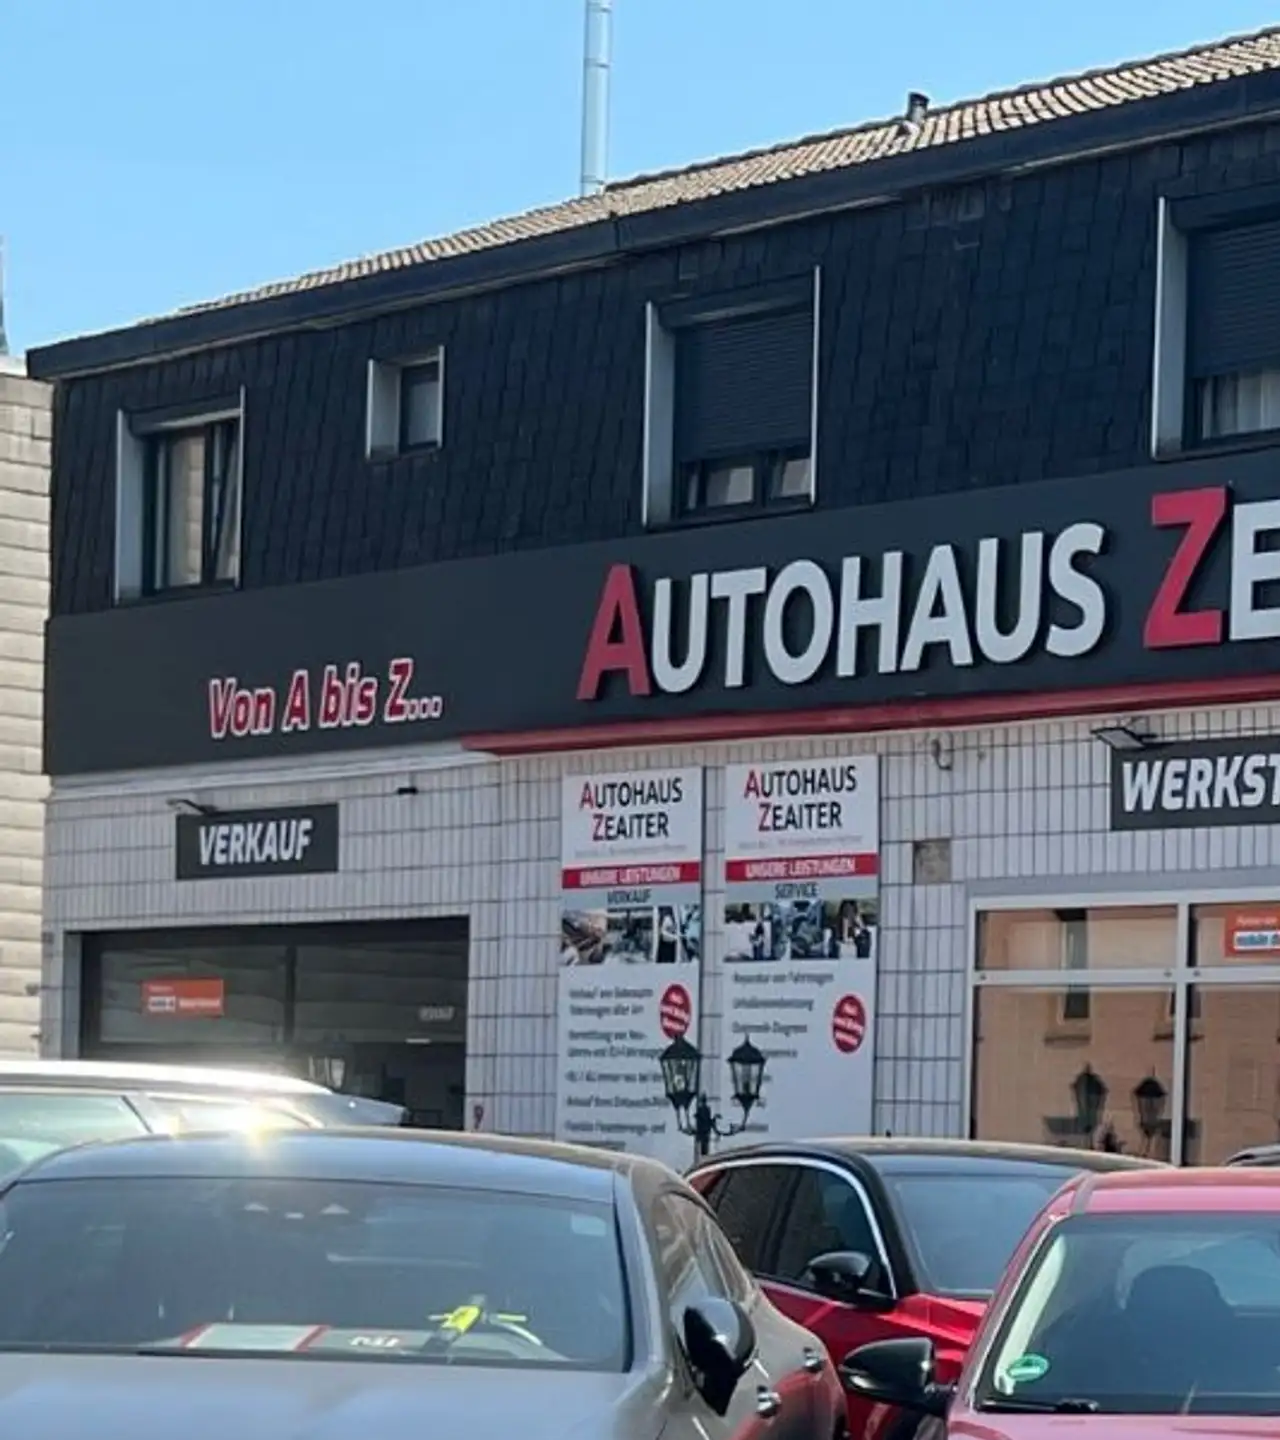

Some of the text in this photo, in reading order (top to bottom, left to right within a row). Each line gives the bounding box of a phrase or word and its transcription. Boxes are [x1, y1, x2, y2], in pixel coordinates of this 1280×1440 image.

[576, 520, 1106, 702] AUTOHAUS
[209, 676, 275, 738] Von
[281, 669, 310, 731] A
[318, 661, 378, 728] bis
[580, 777, 683, 809] AUTOHAUS
[744, 766, 857, 799] AUTOHAUS
[593, 811, 669, 841] ZEAITER
[758, 801, 842, 832] ZEAITER
[199, 818, 314, 866] VERKAUF
[775, 882, 819, 899] SERVICE
